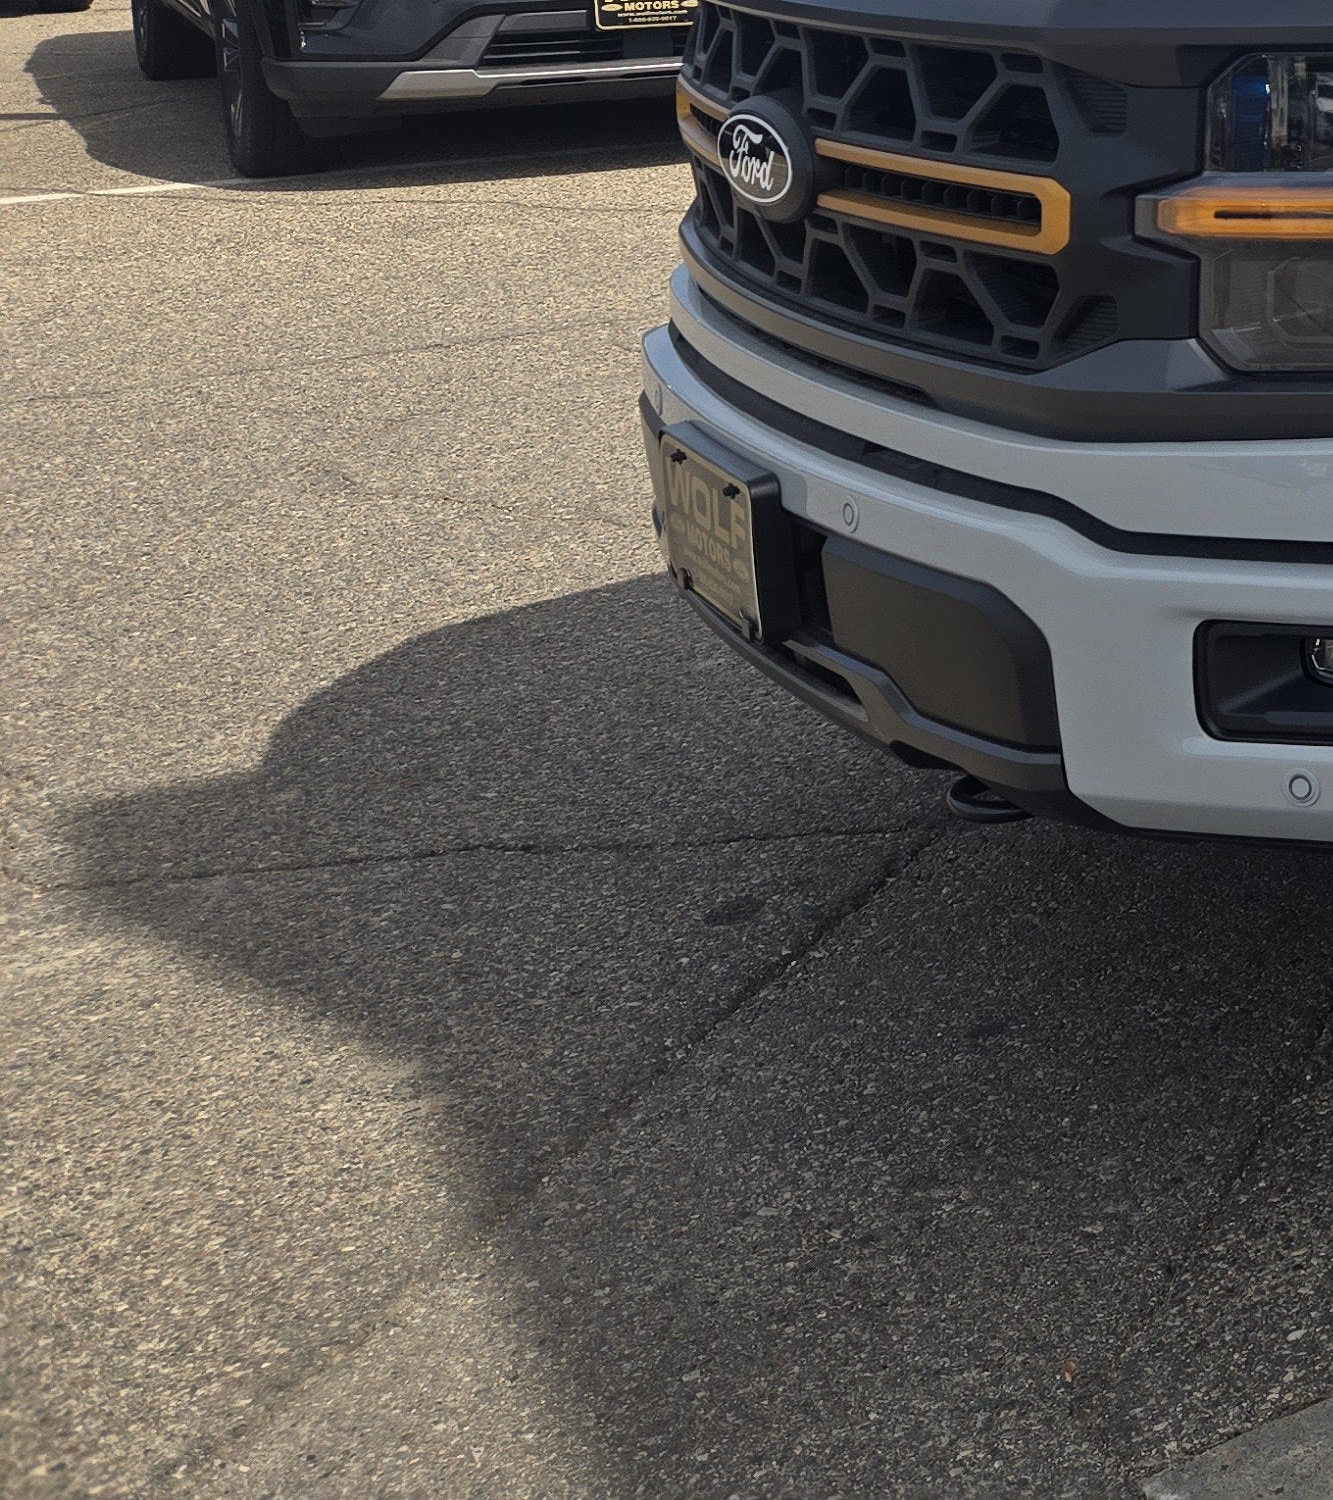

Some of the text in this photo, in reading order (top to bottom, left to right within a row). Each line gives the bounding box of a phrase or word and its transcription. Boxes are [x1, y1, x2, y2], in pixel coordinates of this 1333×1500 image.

[624, 0, 680, 12] MOTORS
[729, 124, 775, 191] Ford
[666, 456, 746, 549] WOLF
[686, 520, 732, 573] MOTORS
